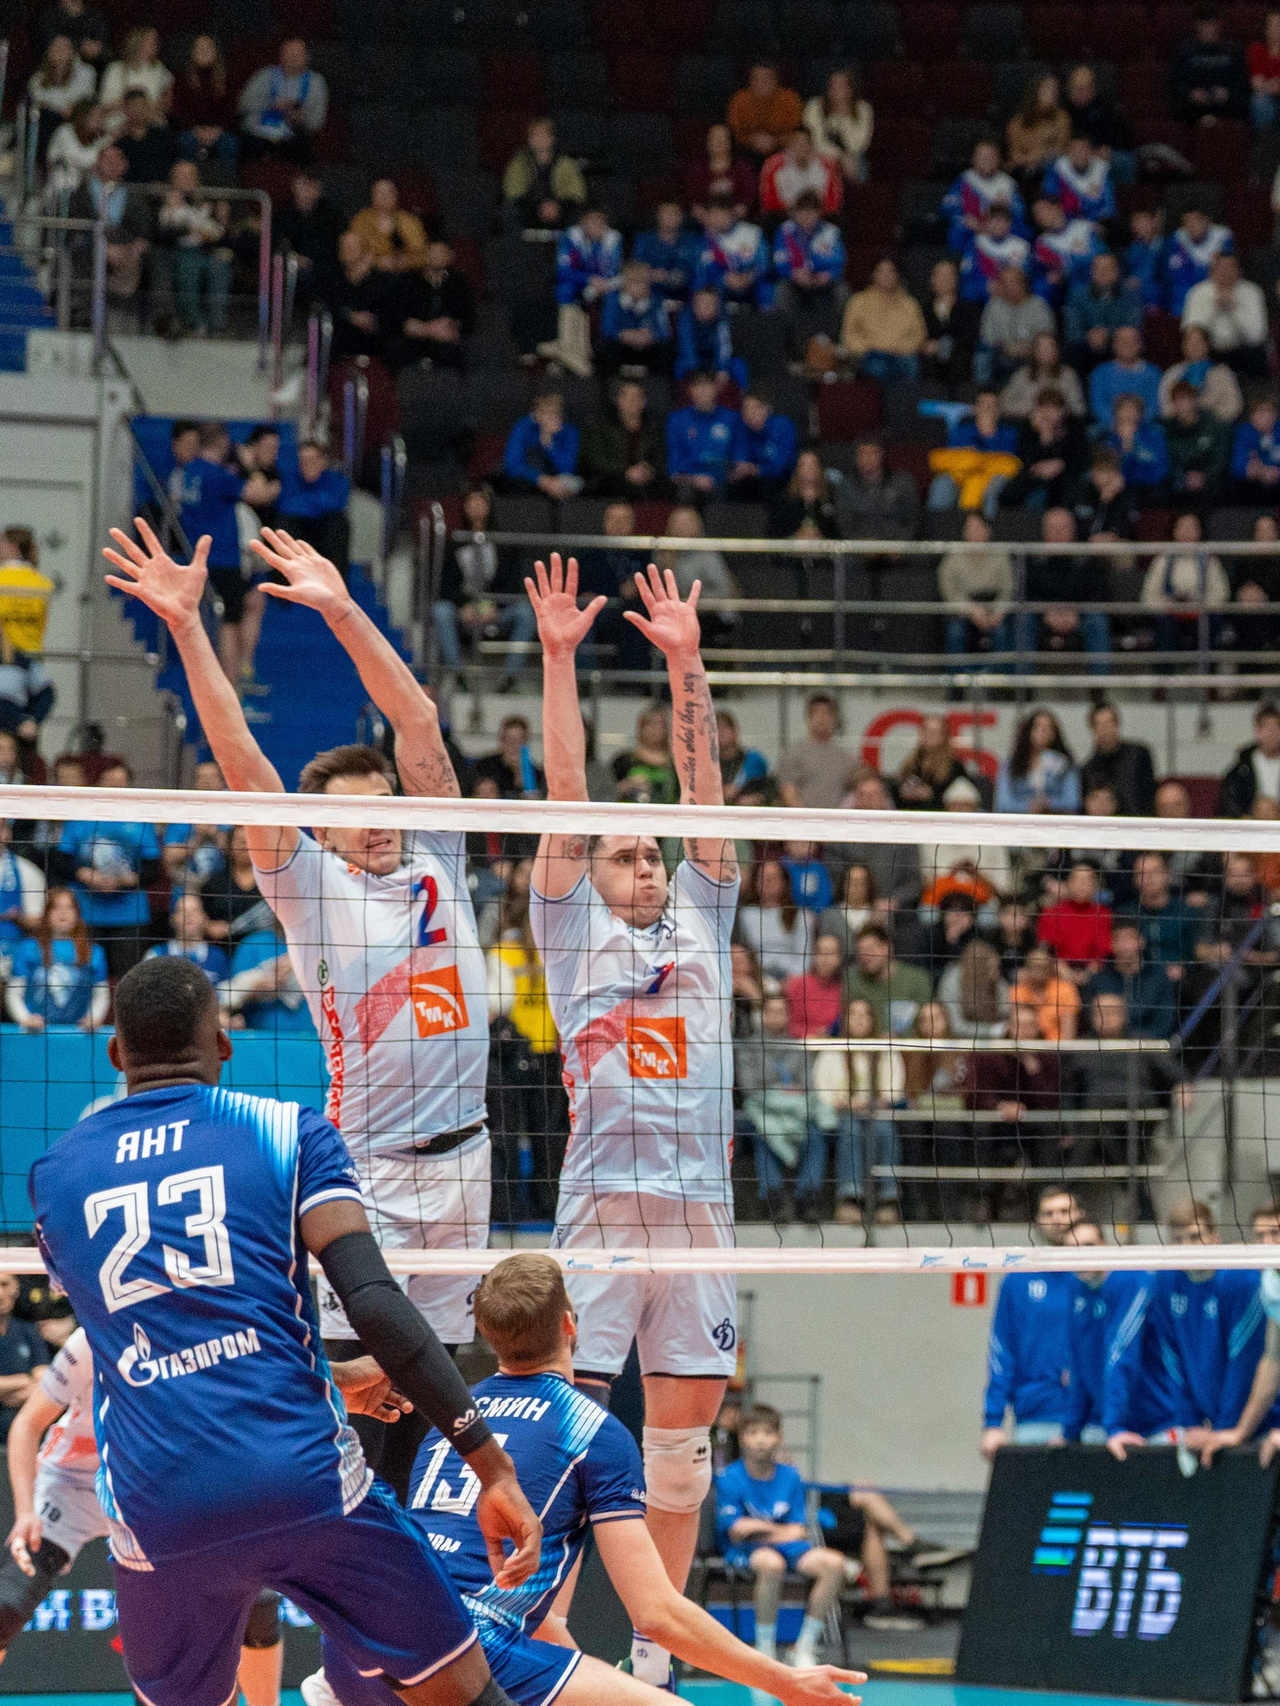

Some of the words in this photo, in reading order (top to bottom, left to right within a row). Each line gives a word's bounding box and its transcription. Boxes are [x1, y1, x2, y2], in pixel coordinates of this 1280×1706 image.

[412, 876, 447, 947] 2
[416, 1001, 456, 1028] TMK
[632, 1043, 670, 1075] TMK
[115, 1119, 190, 1164] ЯНТ
[84, 1165, 235, 1314] 23
[154, 1328, 262, 1380] ГАЗПРОМ
[1071, 1522, 1189, 1640] ВТБ
